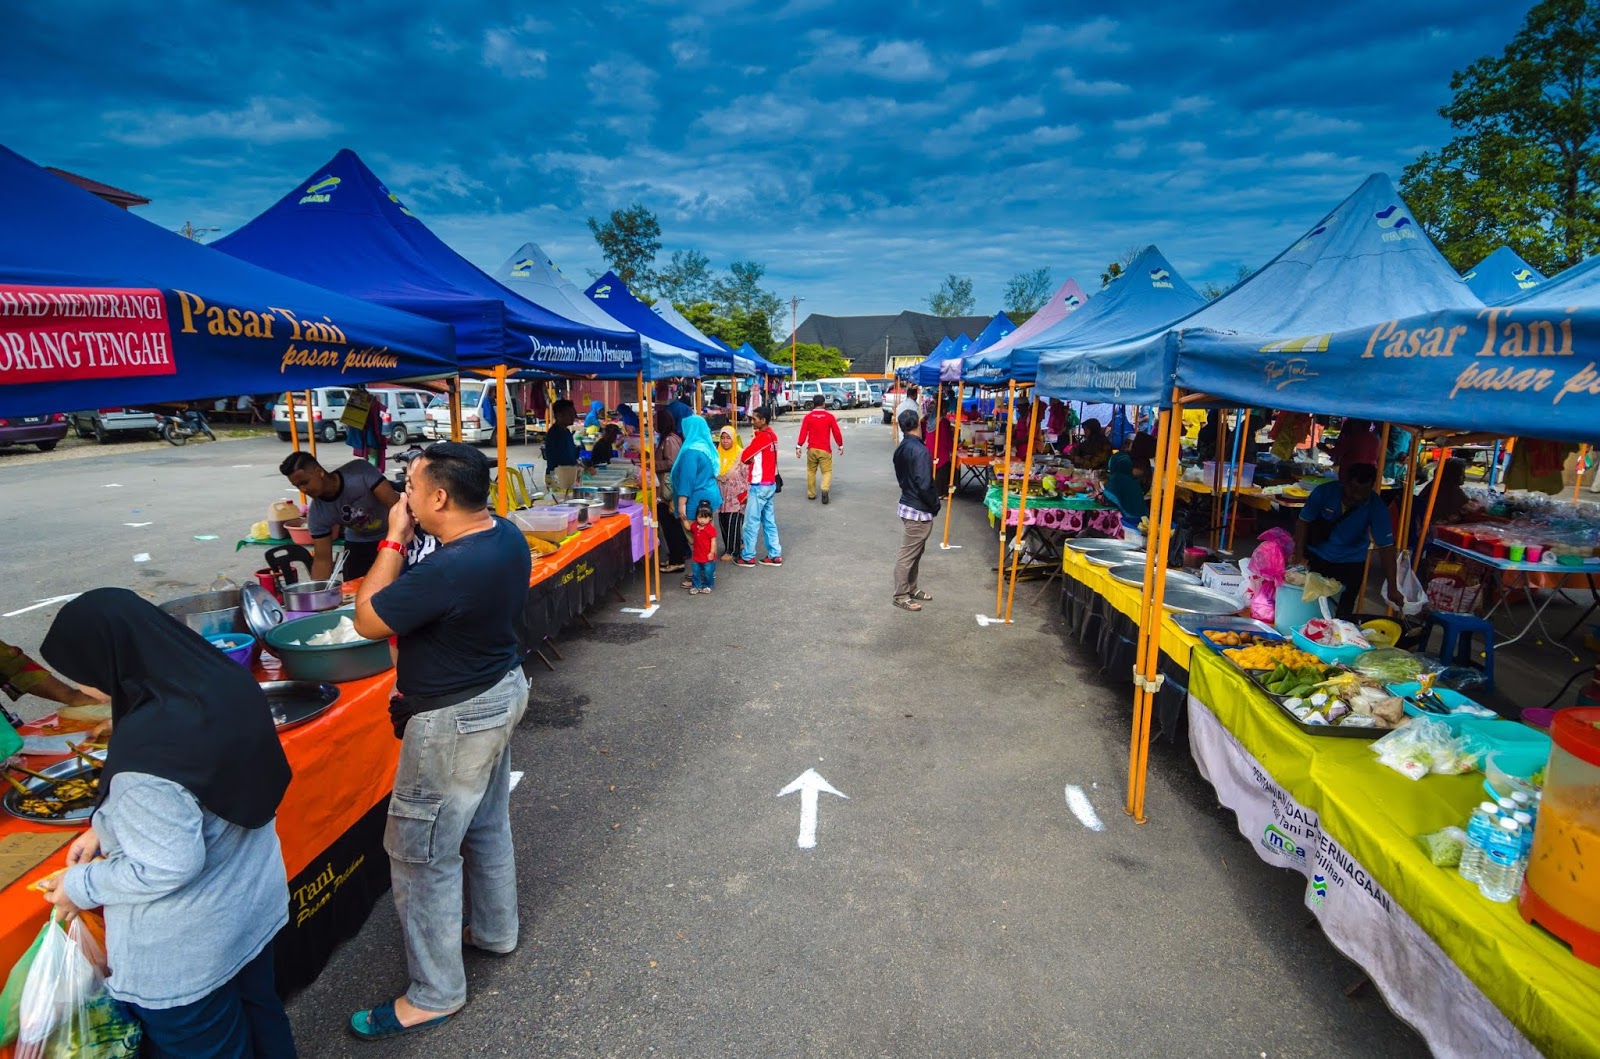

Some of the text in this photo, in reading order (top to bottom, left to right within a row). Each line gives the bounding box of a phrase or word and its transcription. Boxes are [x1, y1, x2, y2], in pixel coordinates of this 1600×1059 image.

[0, 292, 163, 319] HAD MEMERANGI
[172, 289, 347, 344] Pasar Tani
[79, 331, 169, 367] TENGAH
[528, 335, 577, 362] Pertanian
[576, 339, 602, 362] Adalah
[1361, 305, 1579, 359] Pasar Tani
[281, 343, 339, 374] pasar
[1450, 362, 1555, 399] pasar
[1279, 814, 1302, 835] Tani
[1269, 832, 1306, 858] moa
[293, 862, 336, 910] Tani
[1314, 850, 1345, 888] Pilihan
